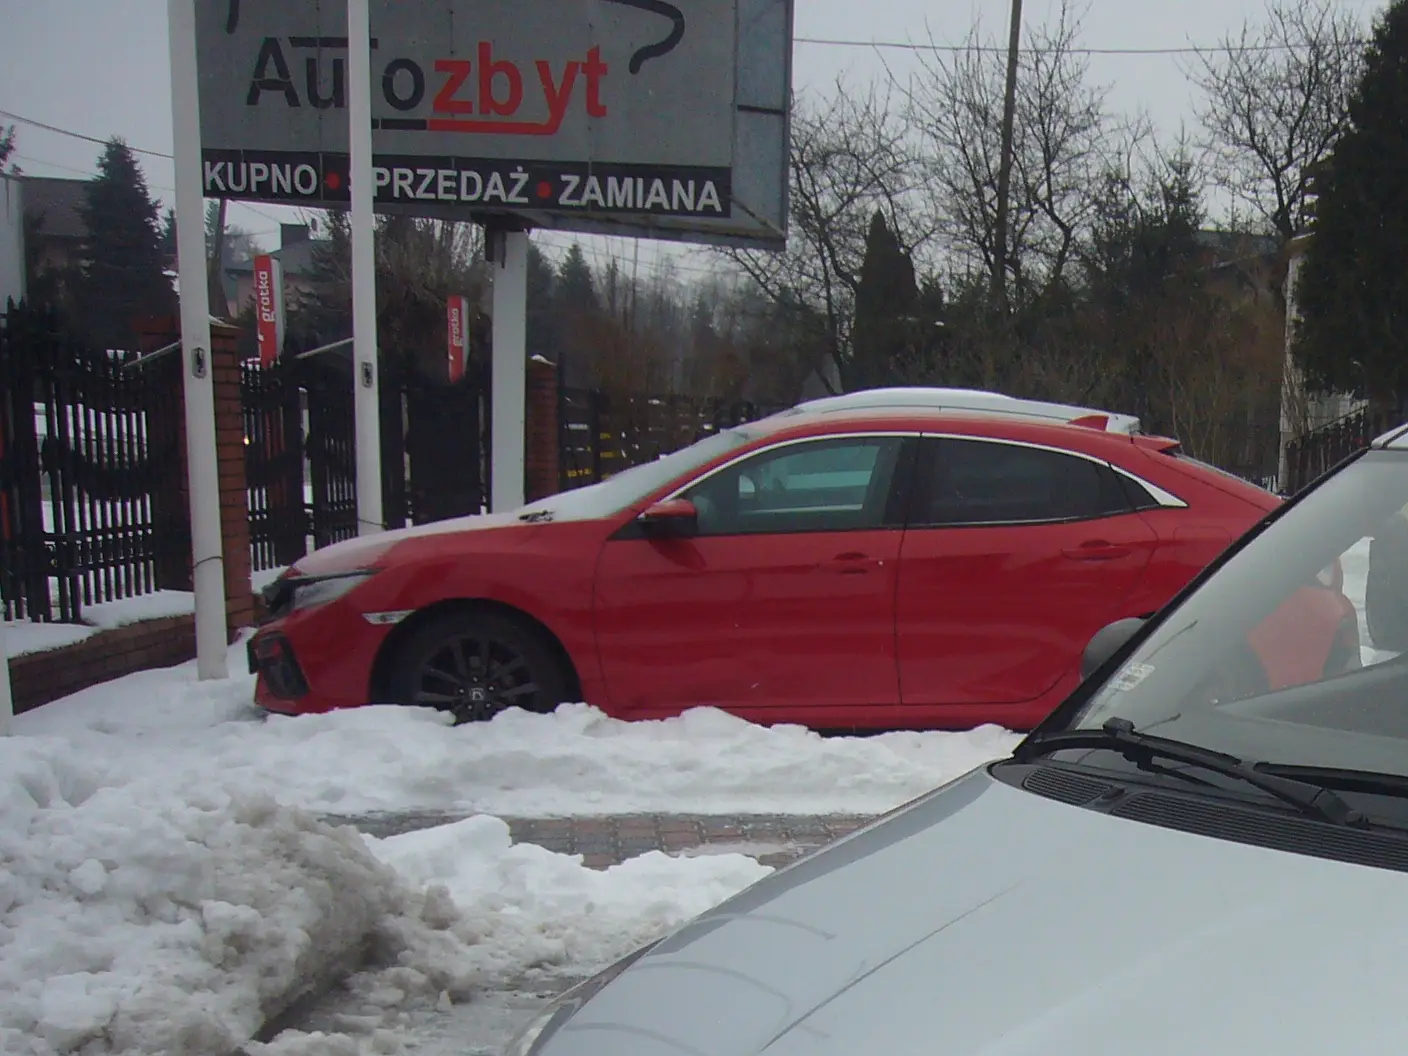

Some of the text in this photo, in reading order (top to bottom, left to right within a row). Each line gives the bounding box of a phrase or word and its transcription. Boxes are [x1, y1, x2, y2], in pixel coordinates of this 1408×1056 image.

[204, 161, 722, 212] KUPNO PRZEDAŻ ZAMIANA
[258, 270, 276, 322] gratka
